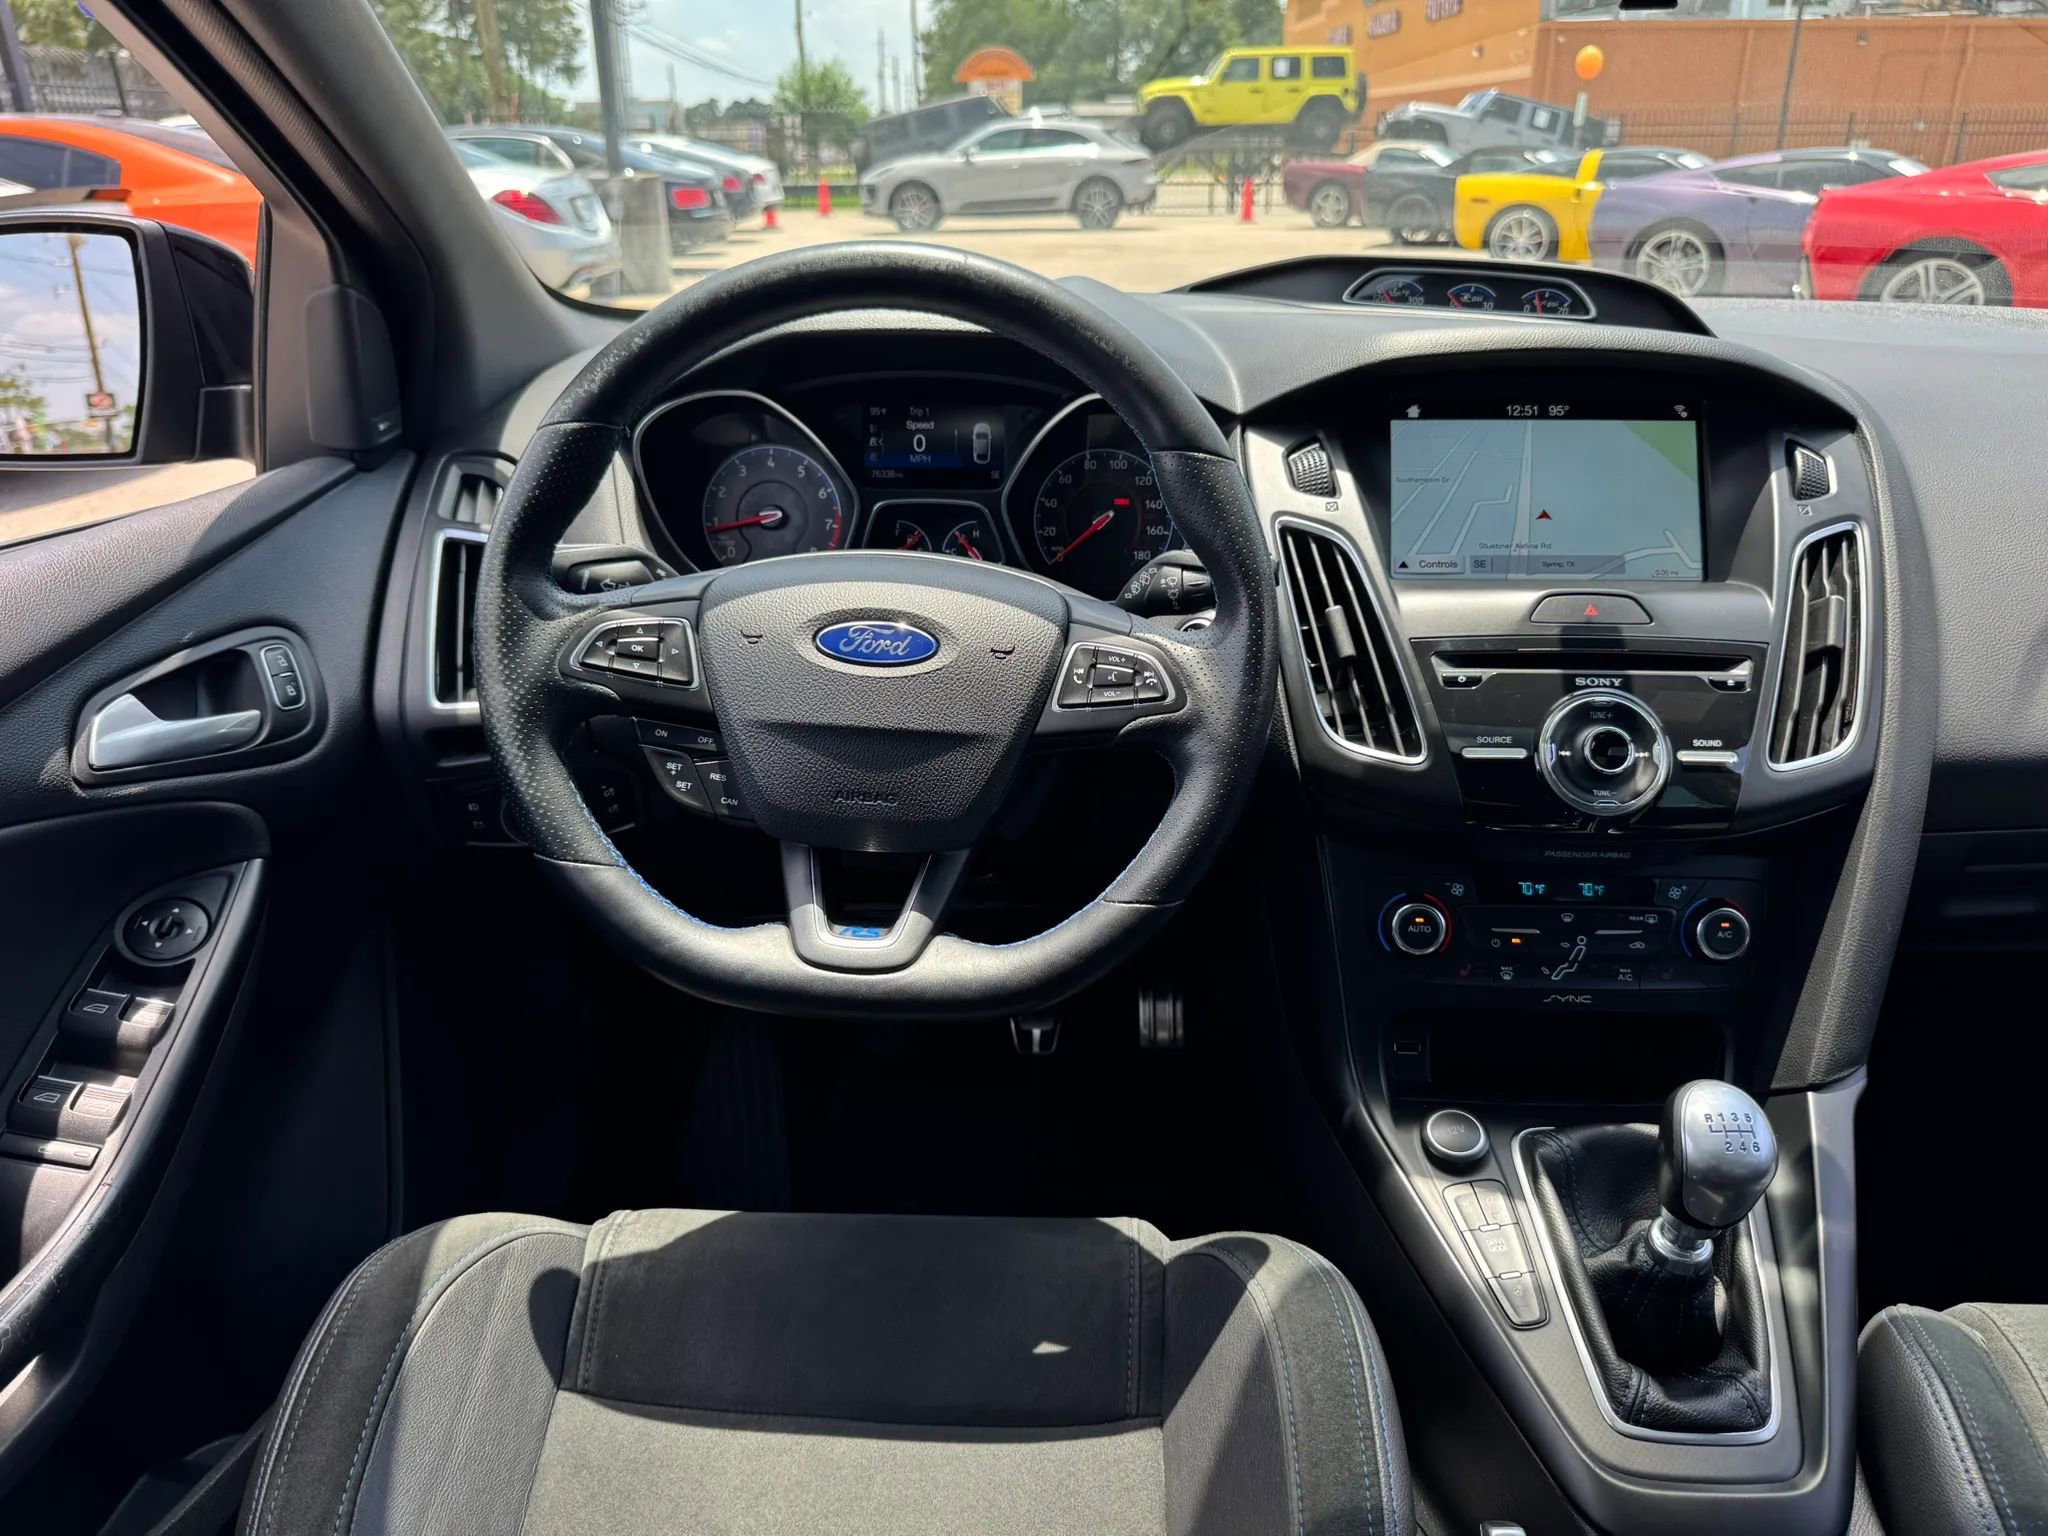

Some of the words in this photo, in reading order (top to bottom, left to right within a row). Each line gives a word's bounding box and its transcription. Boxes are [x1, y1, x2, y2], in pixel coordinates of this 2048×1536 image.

[1407, 296, 1424, 306] 300
[1481, 301, 1494, 311] 30
[1523, 304, 1530, 313] 0
[1557, 306, 1569, 316] 20
[909, 406, 924, 417] Trip
[1506, 405, 1538, 416] 12:51
[1549, 405, 1570, 416] 95°
[906, 420, 935, 431] Speed
[913, 434, 926, 452] 0
[767, 457, 775, 468] 4
[910, 454, 932, 464] MPH
[1083, 460, 1097, 470] 80
[1109, 460, 1127, 470] 100
[739, 465, 747, 477] 3
[798, 465, 806, 477] 5
[1058, 474, 1072, 484] 60
[1135, 476, 1152, 486] 120
[718, 486, 727, 498] 2
[819, 488, 827, 499] 6
[1044, 498, 1057, 508] 40
[1145, 500, 1163, 509] 140
[713, 517, 719, 528] 1
[825, 519, 833, 530] 7
[1043, 527, 1056, 537] 20
[1146, 526, 1164, 536] 160
[1479, 542, 1513, 550] Stuebner
[1515, 542, 1539, 550] Airline
[1541, 542, 1552, 550] Rd
[727, 546, 736, 558] 0
[1133, 550, 1151, 561] 180
[1419, 559, 1458, 569] Controls
[1473, 559, 1486, 569] SE
[839, 625, 912, 656] Ford
[631, 644, 644, 653] OK
[1575, 677, 1623, 687] SONY
[655, 729, 668, 738] ON
[697, 736, 714, 745] OFF
[1476, 736, 1512, 744] SOURCE
[1692, 739, 1723, 747] SOUND
[666, 762, 683, 771] SET
[709, 772, 727, 781] RES
[676, 780, 693, 790] SET
[720, 796, 739, 806] CAN
[1544, 850, 1597, 858] PASSENGER
[1598, 851, 1632, 859] AIRBAG
[1517, 881, 1546, 895] 70°F
[1578, 882, 1605, 896] 70°F
[1407, 925, 1432, 933] AUTO
[1717, 930, 1733, 939] A/C
[1617, 973, 1633, 981] A/C
[1543, 995, 1592, 1003] SYNC
[1704, 1113, 1714, 1123] R
[1717, 1112, 1725, 1122] 1
[1731, 1112, 1739, 1122] 3
[1744, 1113, 1752, 1122] 5
[1447, 1124, 1464, 1136] 12V
[1725, 1141, 1734, 1152] 2
[1739, 1141, 1748, 1152] 4
[1752, 1141, 1760, 1152] 6
